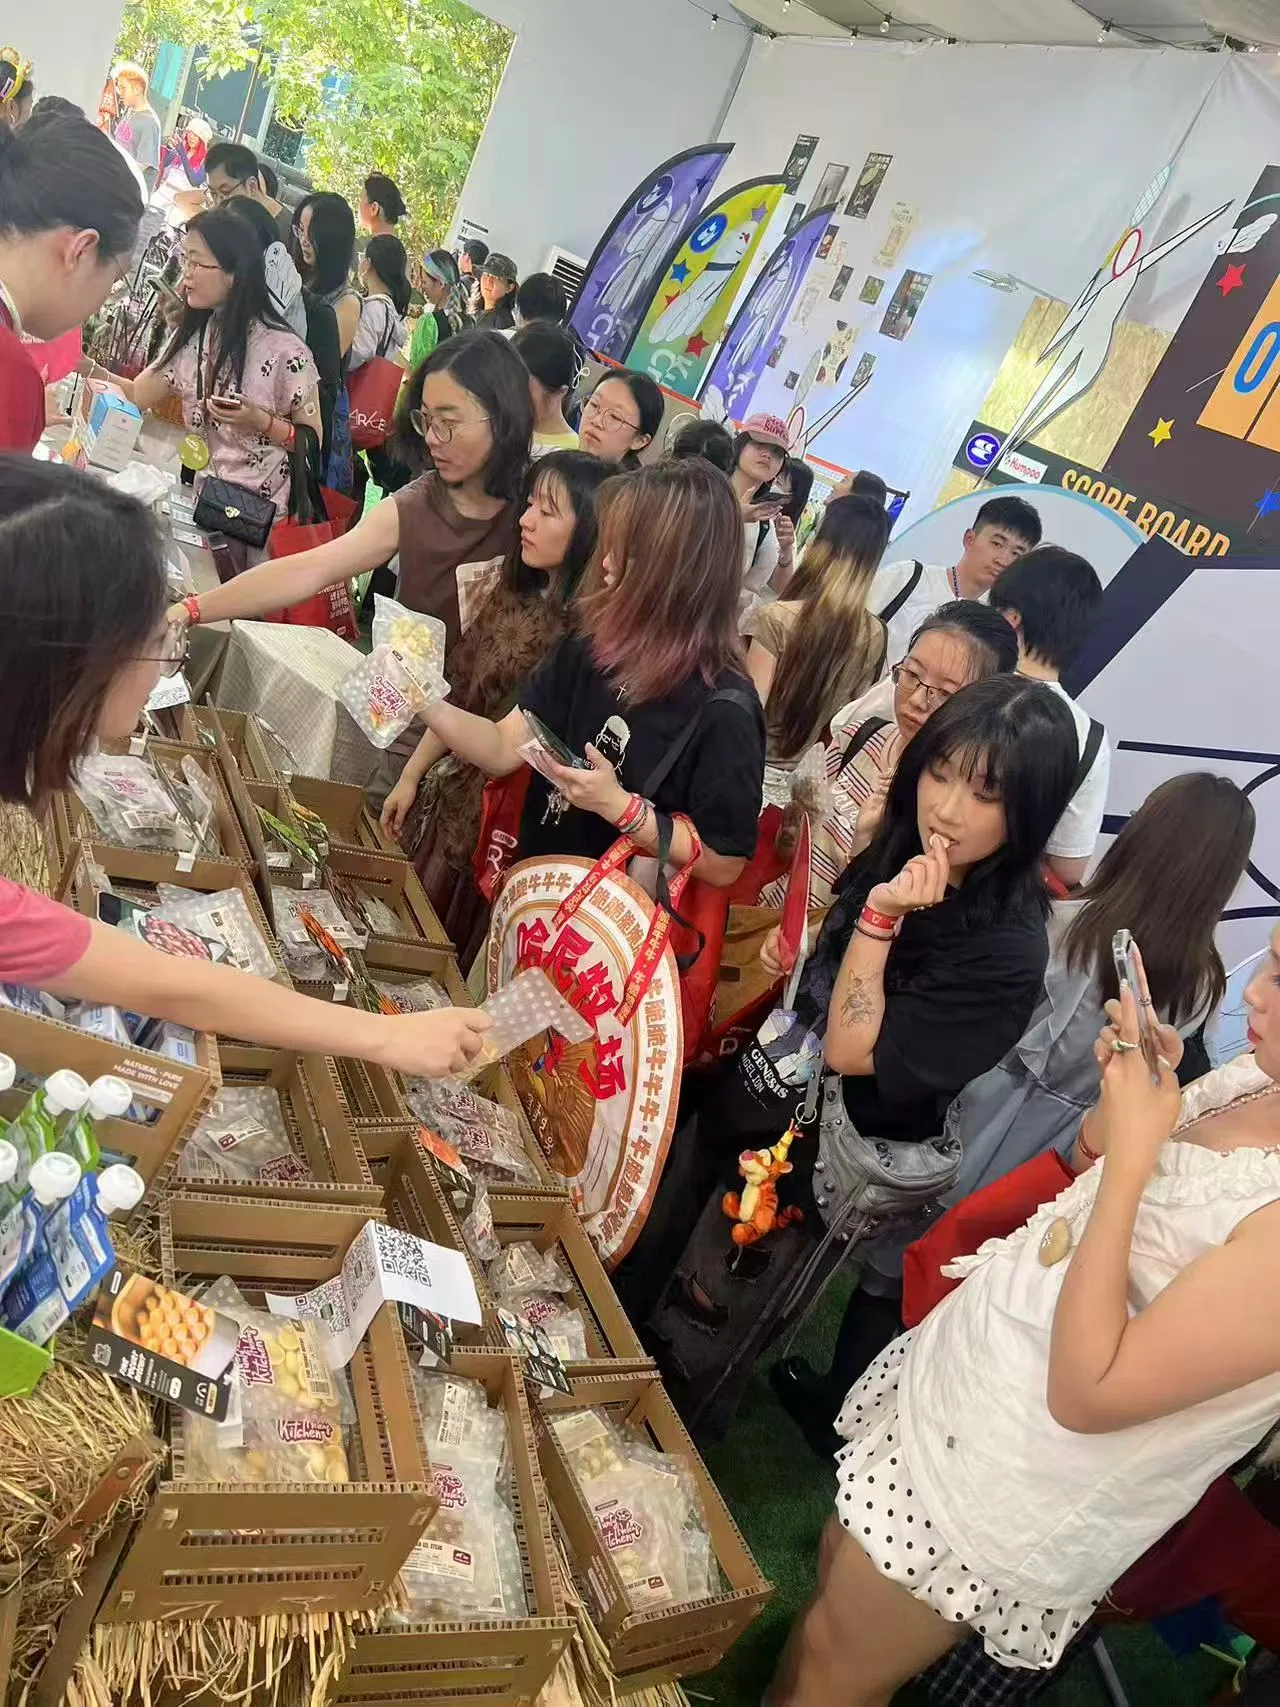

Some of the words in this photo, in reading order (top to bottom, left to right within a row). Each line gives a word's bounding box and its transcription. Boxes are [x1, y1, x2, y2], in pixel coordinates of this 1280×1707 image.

[1009, 457, 1042, 481] Kumpoo
[1135, 501, 1231, 557] BOARD
[112, 1064, 137, 1077] MADE
[137, 1071, 159, 1083] WITH
[158, 1079, 180, 1090] LOVE
[123, 1059, 158, 1075] NATURAL
[163, 1071, 184, 1083] PURE
[751, 1048, 789, 1099] GENESIS
[251, 1340, 272, 1383] Kitchen
[278, 1418, 323, 1441] Kitchen
